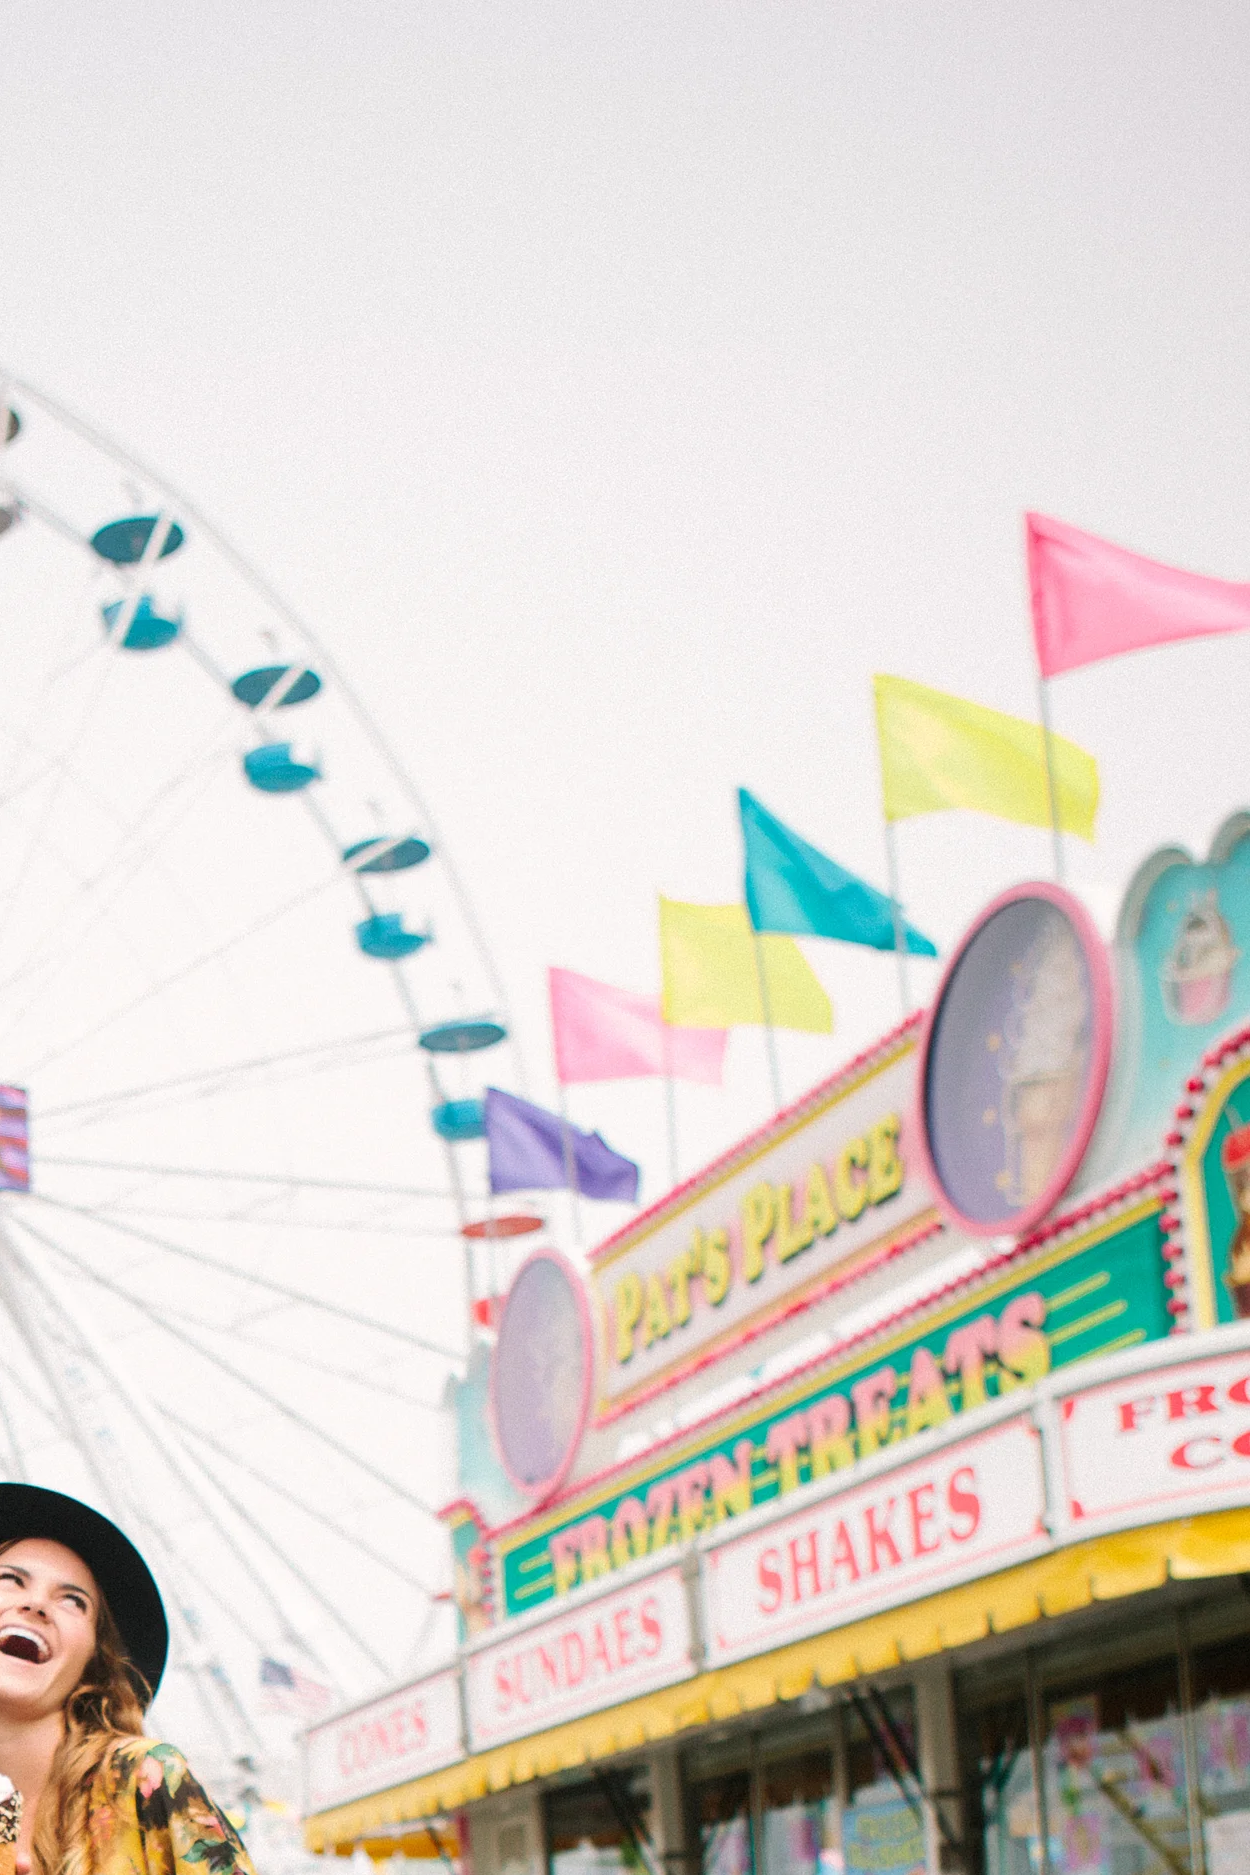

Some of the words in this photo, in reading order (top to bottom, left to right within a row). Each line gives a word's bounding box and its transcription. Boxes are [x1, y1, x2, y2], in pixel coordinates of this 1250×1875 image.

[616, 1226, 731, 1364] PAT'S
[742, 1112, 904, 1284] PLACE
[551, 1440, 753, 1596] FROZEN
[766, 1293, 1050, 1496] TREATS
[756, 1466, 981, 1616] SHAKES
[493, 1597, 664, 1713] SUNDAES
[337, 1699, 428, 1777] CONES
